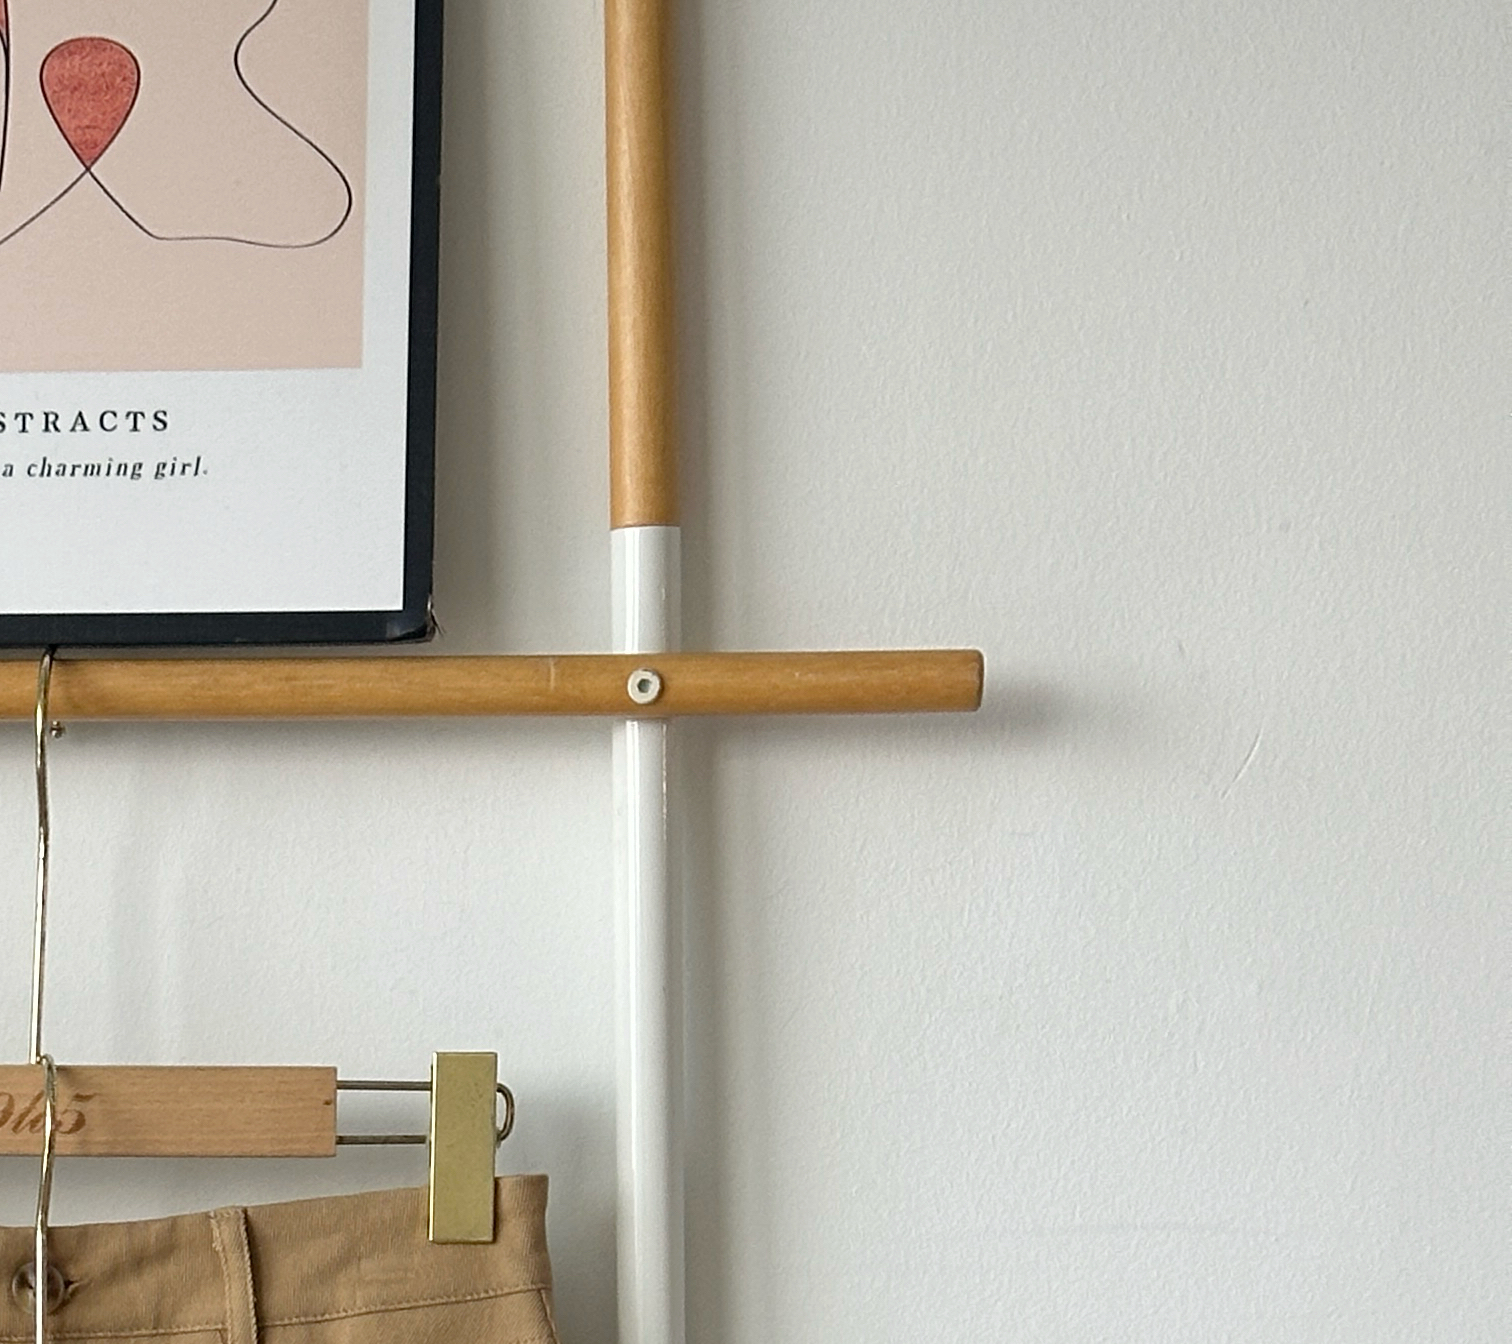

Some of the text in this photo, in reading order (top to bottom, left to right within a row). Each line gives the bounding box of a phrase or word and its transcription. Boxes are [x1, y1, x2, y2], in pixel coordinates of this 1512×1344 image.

[1, 464, 14, 478] a
[26, 456, 144, 480] charming
[153, 455, 209, 480] girl.
